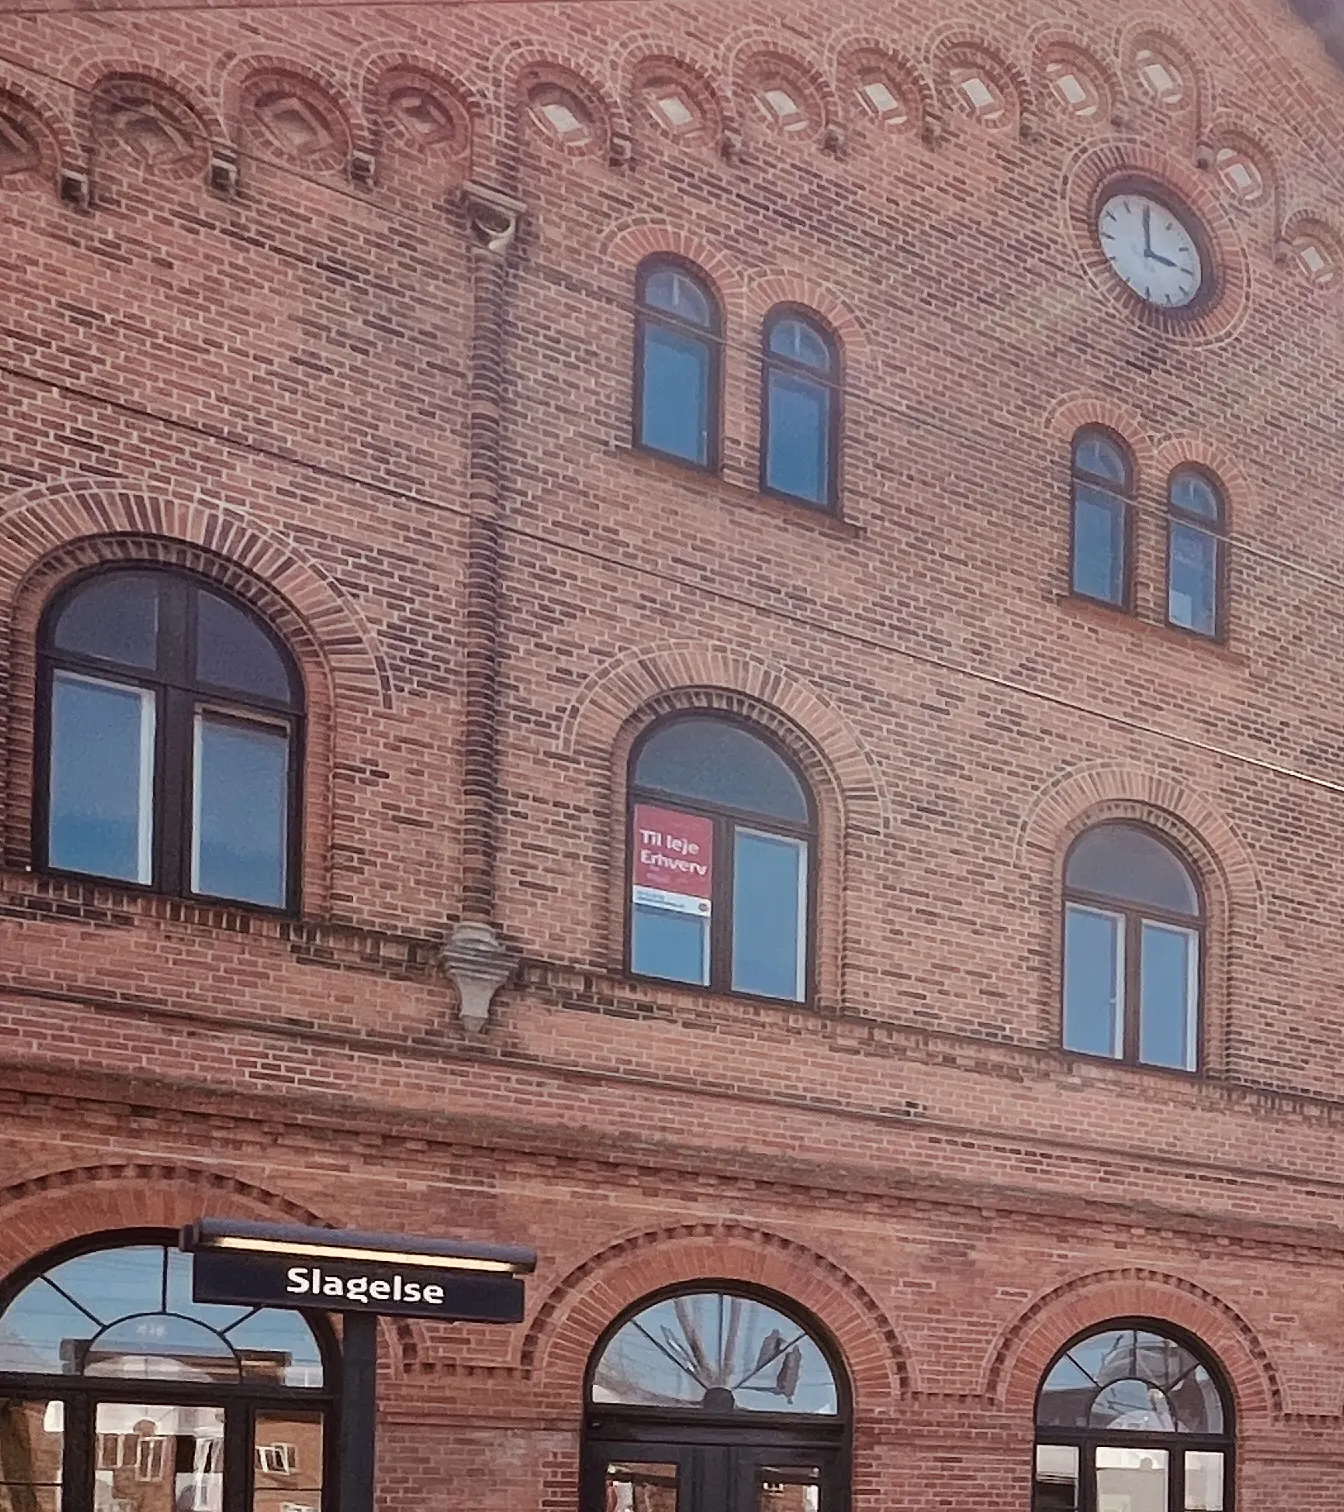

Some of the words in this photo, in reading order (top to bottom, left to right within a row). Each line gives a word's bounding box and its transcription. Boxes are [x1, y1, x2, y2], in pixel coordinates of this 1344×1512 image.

[639, 828, 662, 847] Til
[666, 834, 700, 856] leje
[640, 848, 708, 876] Erhverv
[286, 1266, 445, 1305] Slagelse
